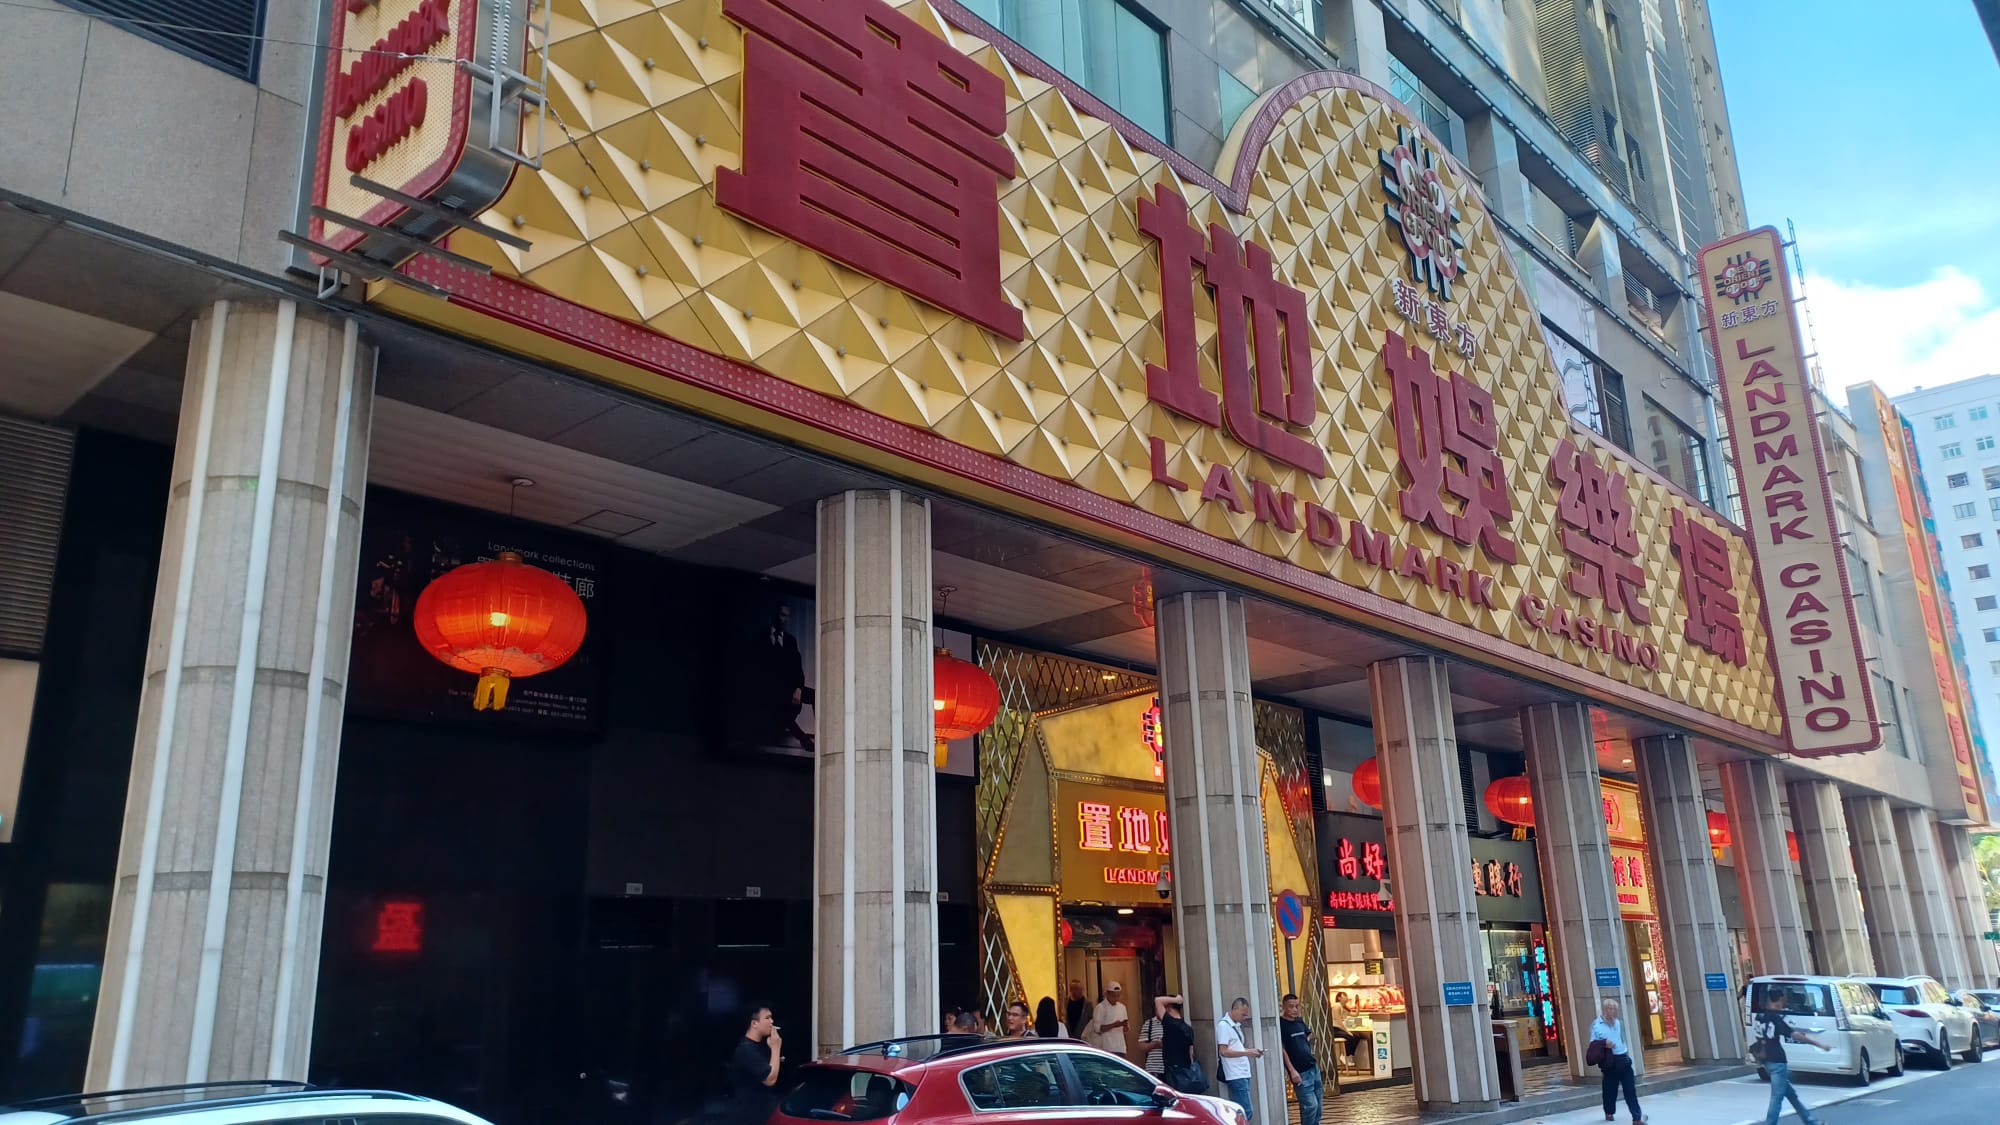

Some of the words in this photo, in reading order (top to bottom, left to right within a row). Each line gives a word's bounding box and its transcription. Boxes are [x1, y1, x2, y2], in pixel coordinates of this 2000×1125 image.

[346, 77, 427, 173] CASINO
[1399, 183, 1452, 241] ORIENT
[1723, 269, 1760, 285] ORIENT
[1391, 277, 1476, 360] 新東方
[1721, 300, 1778, 329] 新東方
[541, 553, 596, 571] collections
[1151, 437, 1497, 611] LANDMARK
[1520, 593, 1659, 672] CASINO
[1735, 337, 1813, 546] LANDMARK
[1778, 561, 1851, 733] CASINO
